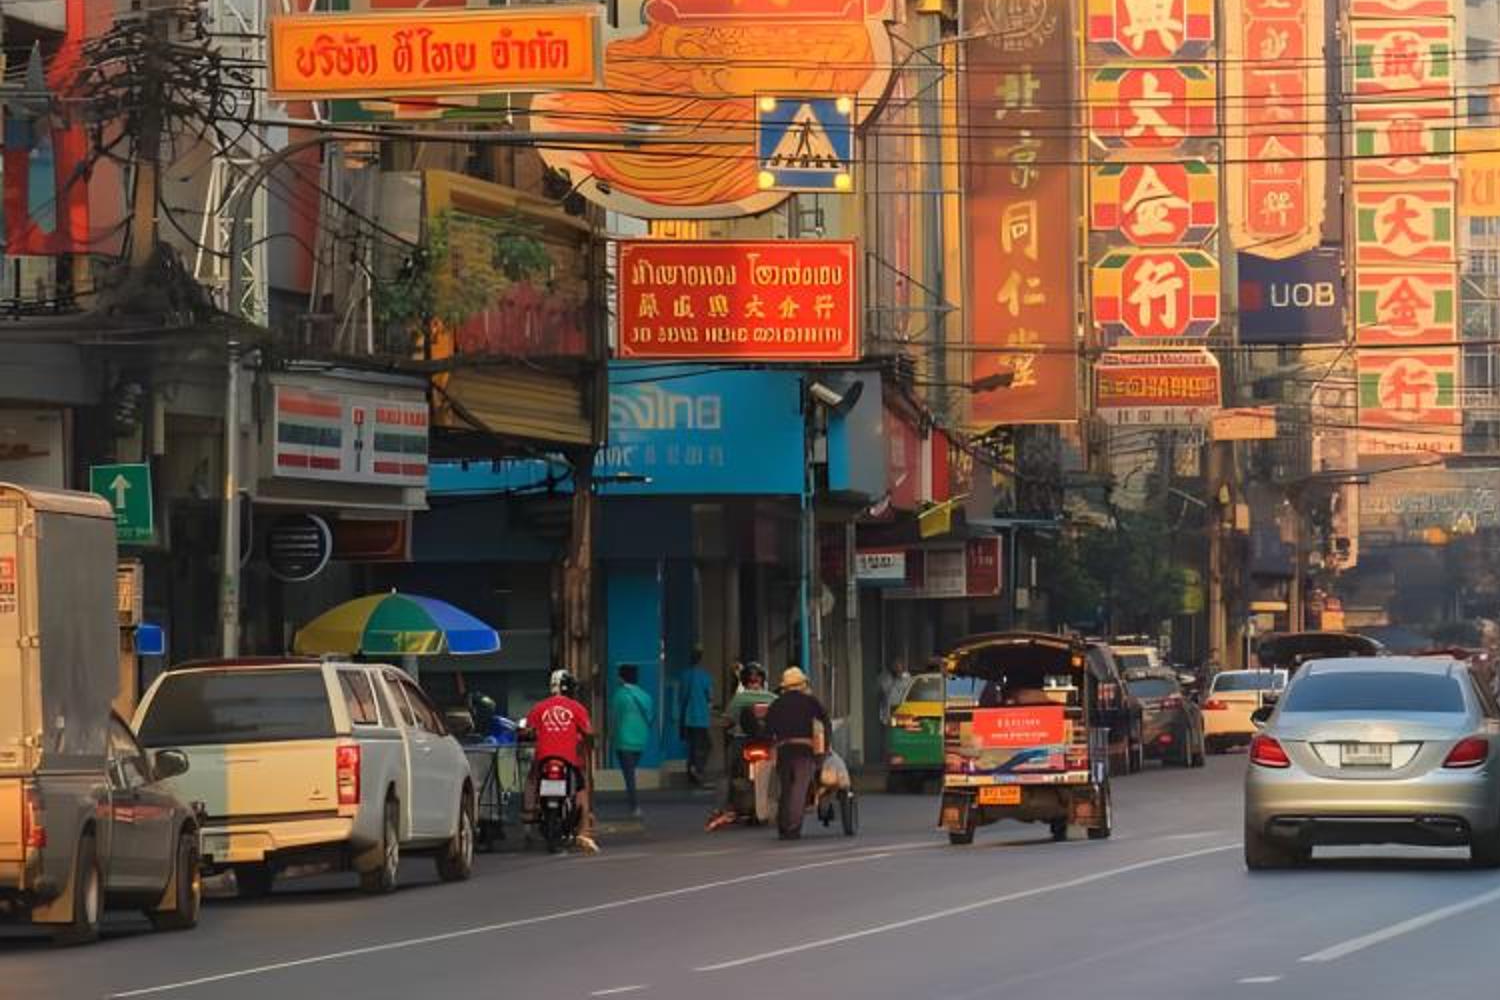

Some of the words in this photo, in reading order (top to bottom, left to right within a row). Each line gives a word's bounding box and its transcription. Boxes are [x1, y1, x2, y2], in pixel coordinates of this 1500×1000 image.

[994, 66, 1047, 387] 北京同仁堂
[1271, 281, 1336, 307] UOB
